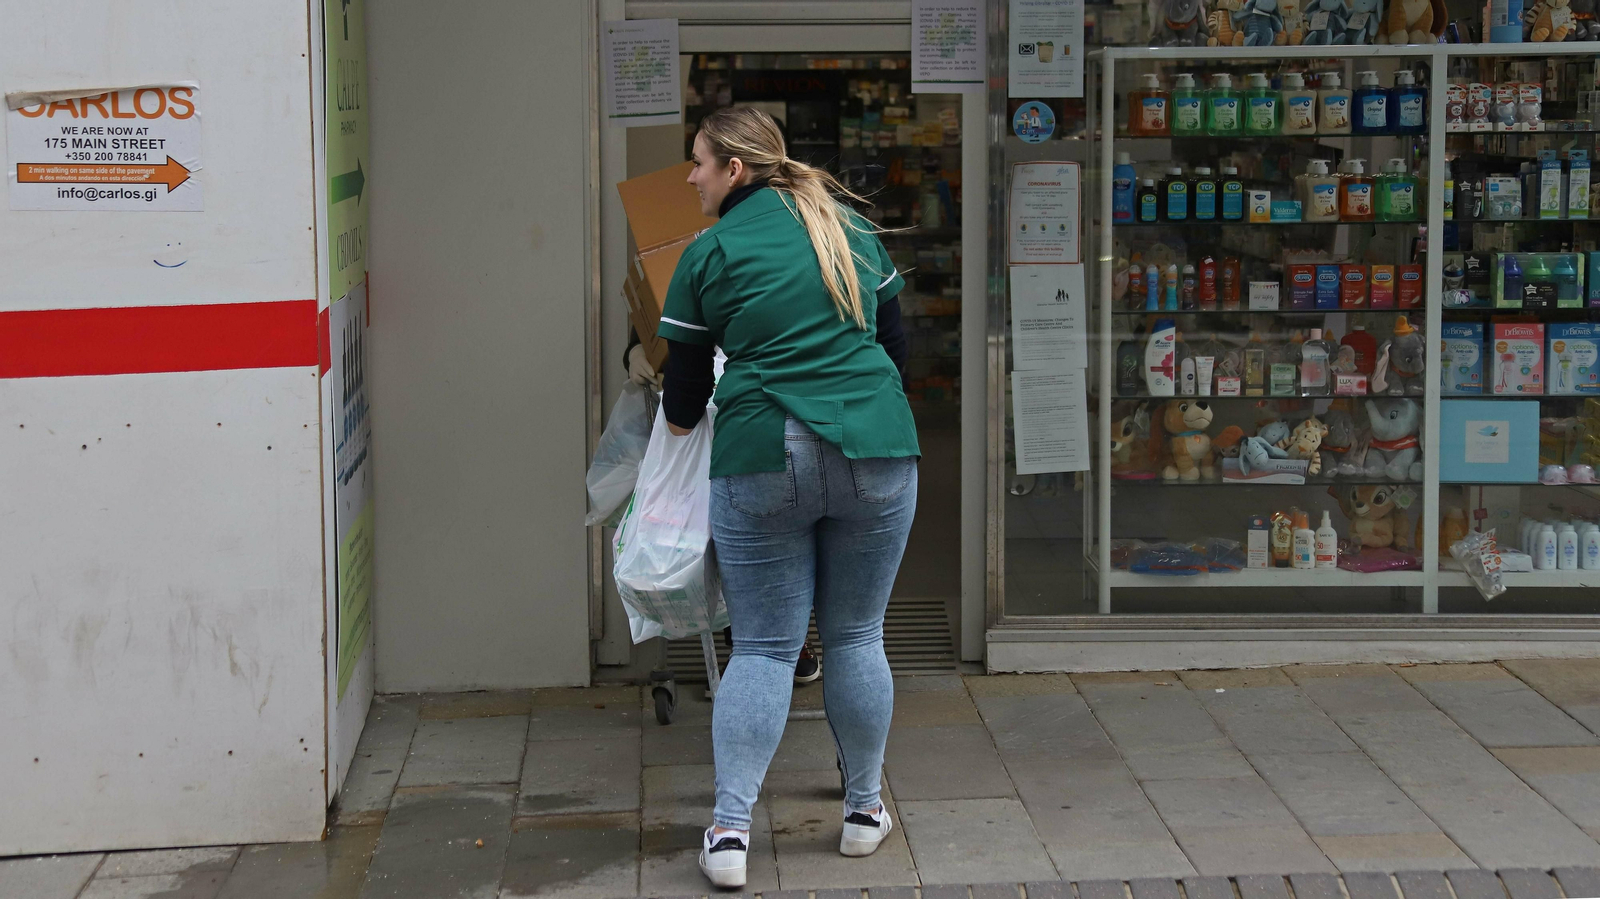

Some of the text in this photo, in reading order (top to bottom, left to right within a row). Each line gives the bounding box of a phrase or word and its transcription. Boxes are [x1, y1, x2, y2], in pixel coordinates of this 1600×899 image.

[336, 58, 360, 112] CALPE
[61, 126, 149, 136] WE ARE NOW AT
[44, 138, 166, 150] 175 MAIN STREET
[65, 152, 147, 162] +350 200 78841
[46, 167, 68, 175] walking
[57, 187, 157, 202] info@carlos.gi
[336, 232, 349, 272] CBD
